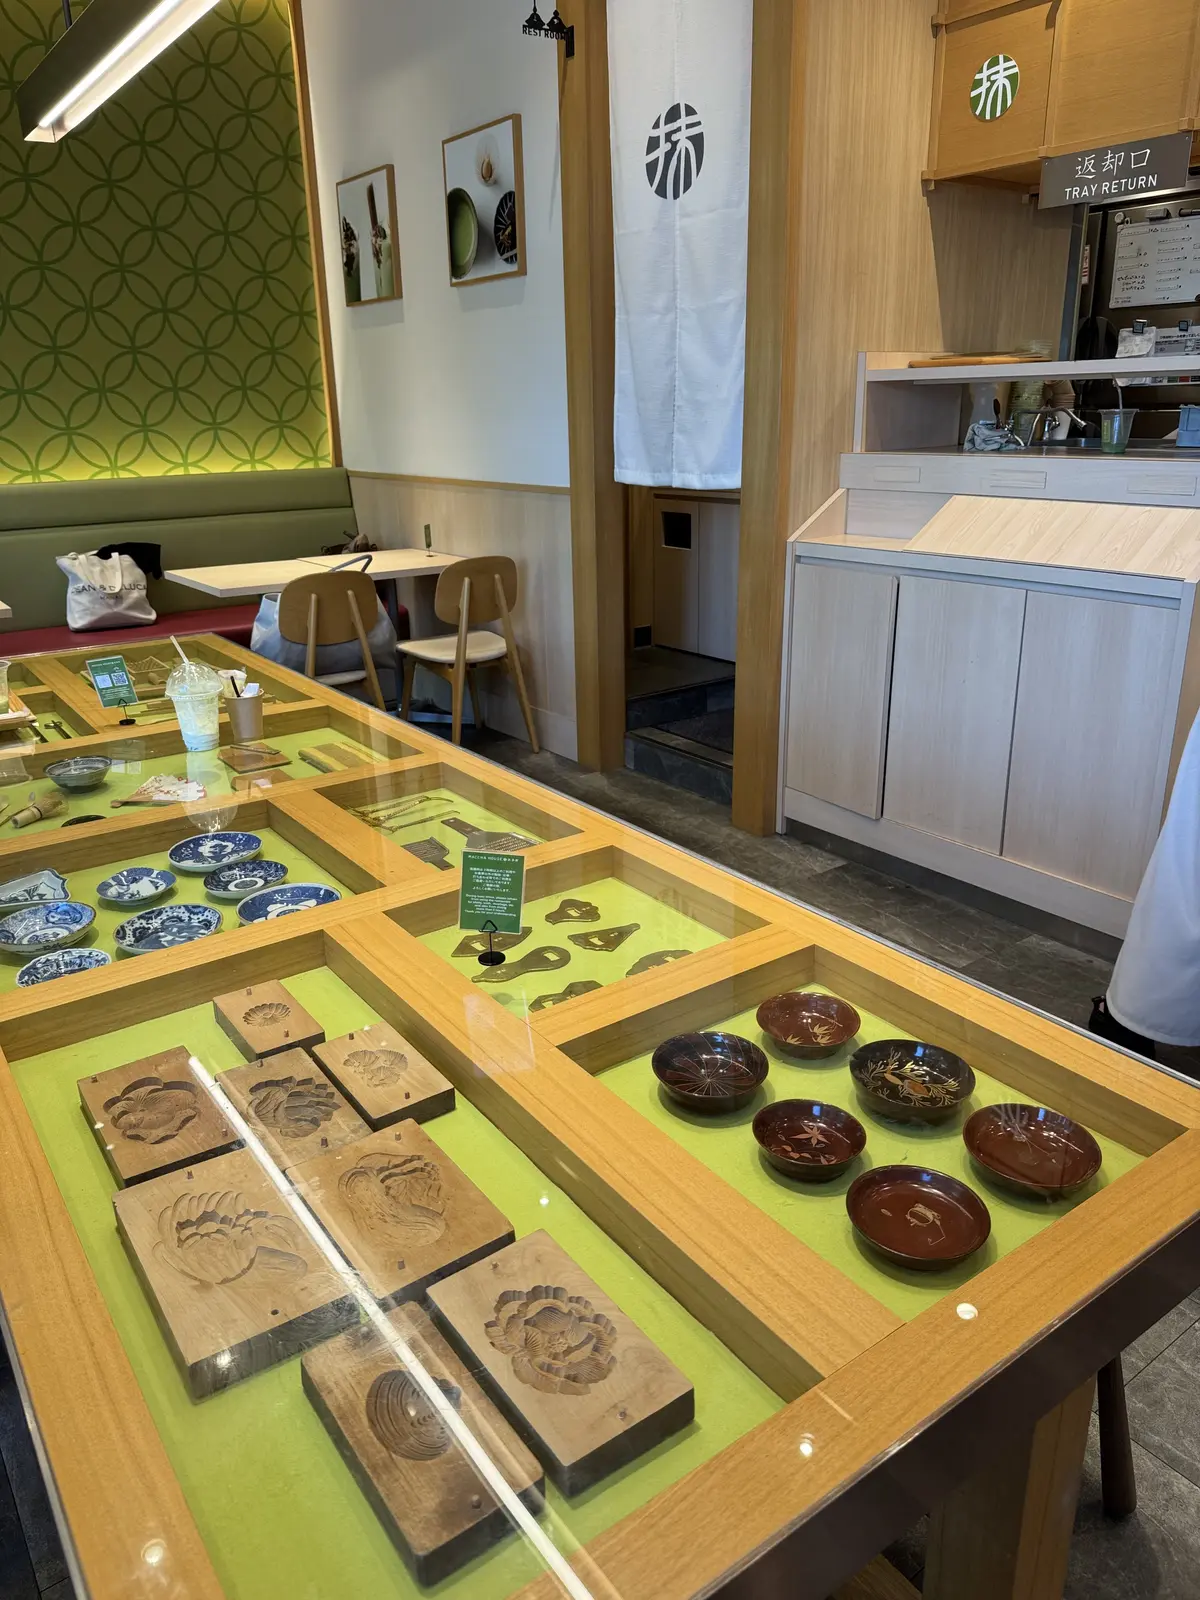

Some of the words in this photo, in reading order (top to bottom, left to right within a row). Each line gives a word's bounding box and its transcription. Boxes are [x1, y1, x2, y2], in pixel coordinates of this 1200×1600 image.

[522, 25, 541, 37] REST
[1075, 149, 1150, 179] 返却口
[1064, 184, 1098, 200] TRAY
[1101, 174, 1158, 195] RETURN
